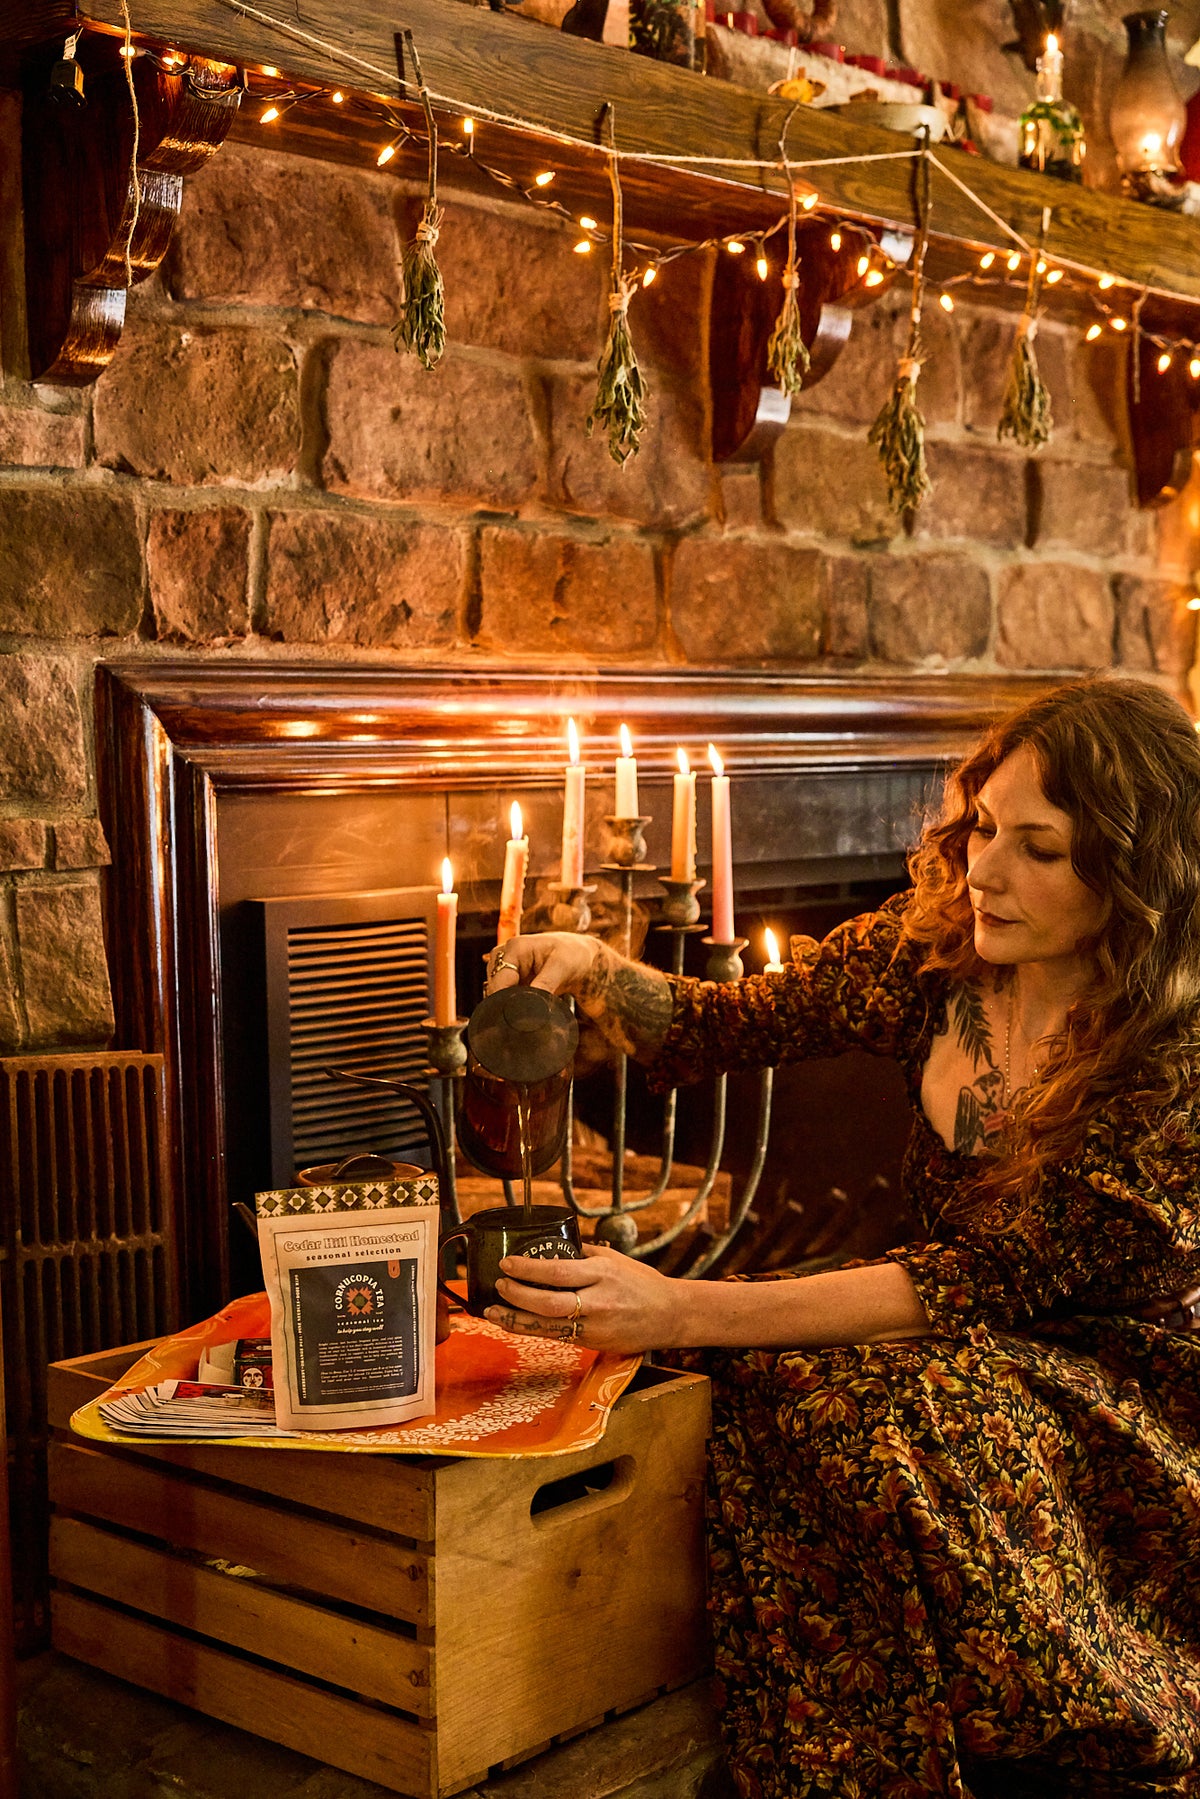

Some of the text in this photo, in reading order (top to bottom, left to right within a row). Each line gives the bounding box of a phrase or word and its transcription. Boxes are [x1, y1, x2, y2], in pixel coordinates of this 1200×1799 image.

[284, 1230, 419, 1252] Cedar Hill Homestead
[522, 1241, 575, 1259] EDAR HILL
[306, 1247, 402, 1261] seasonal selection
[334, 1274, 384, 1310] CORNUCOPIA TEA
